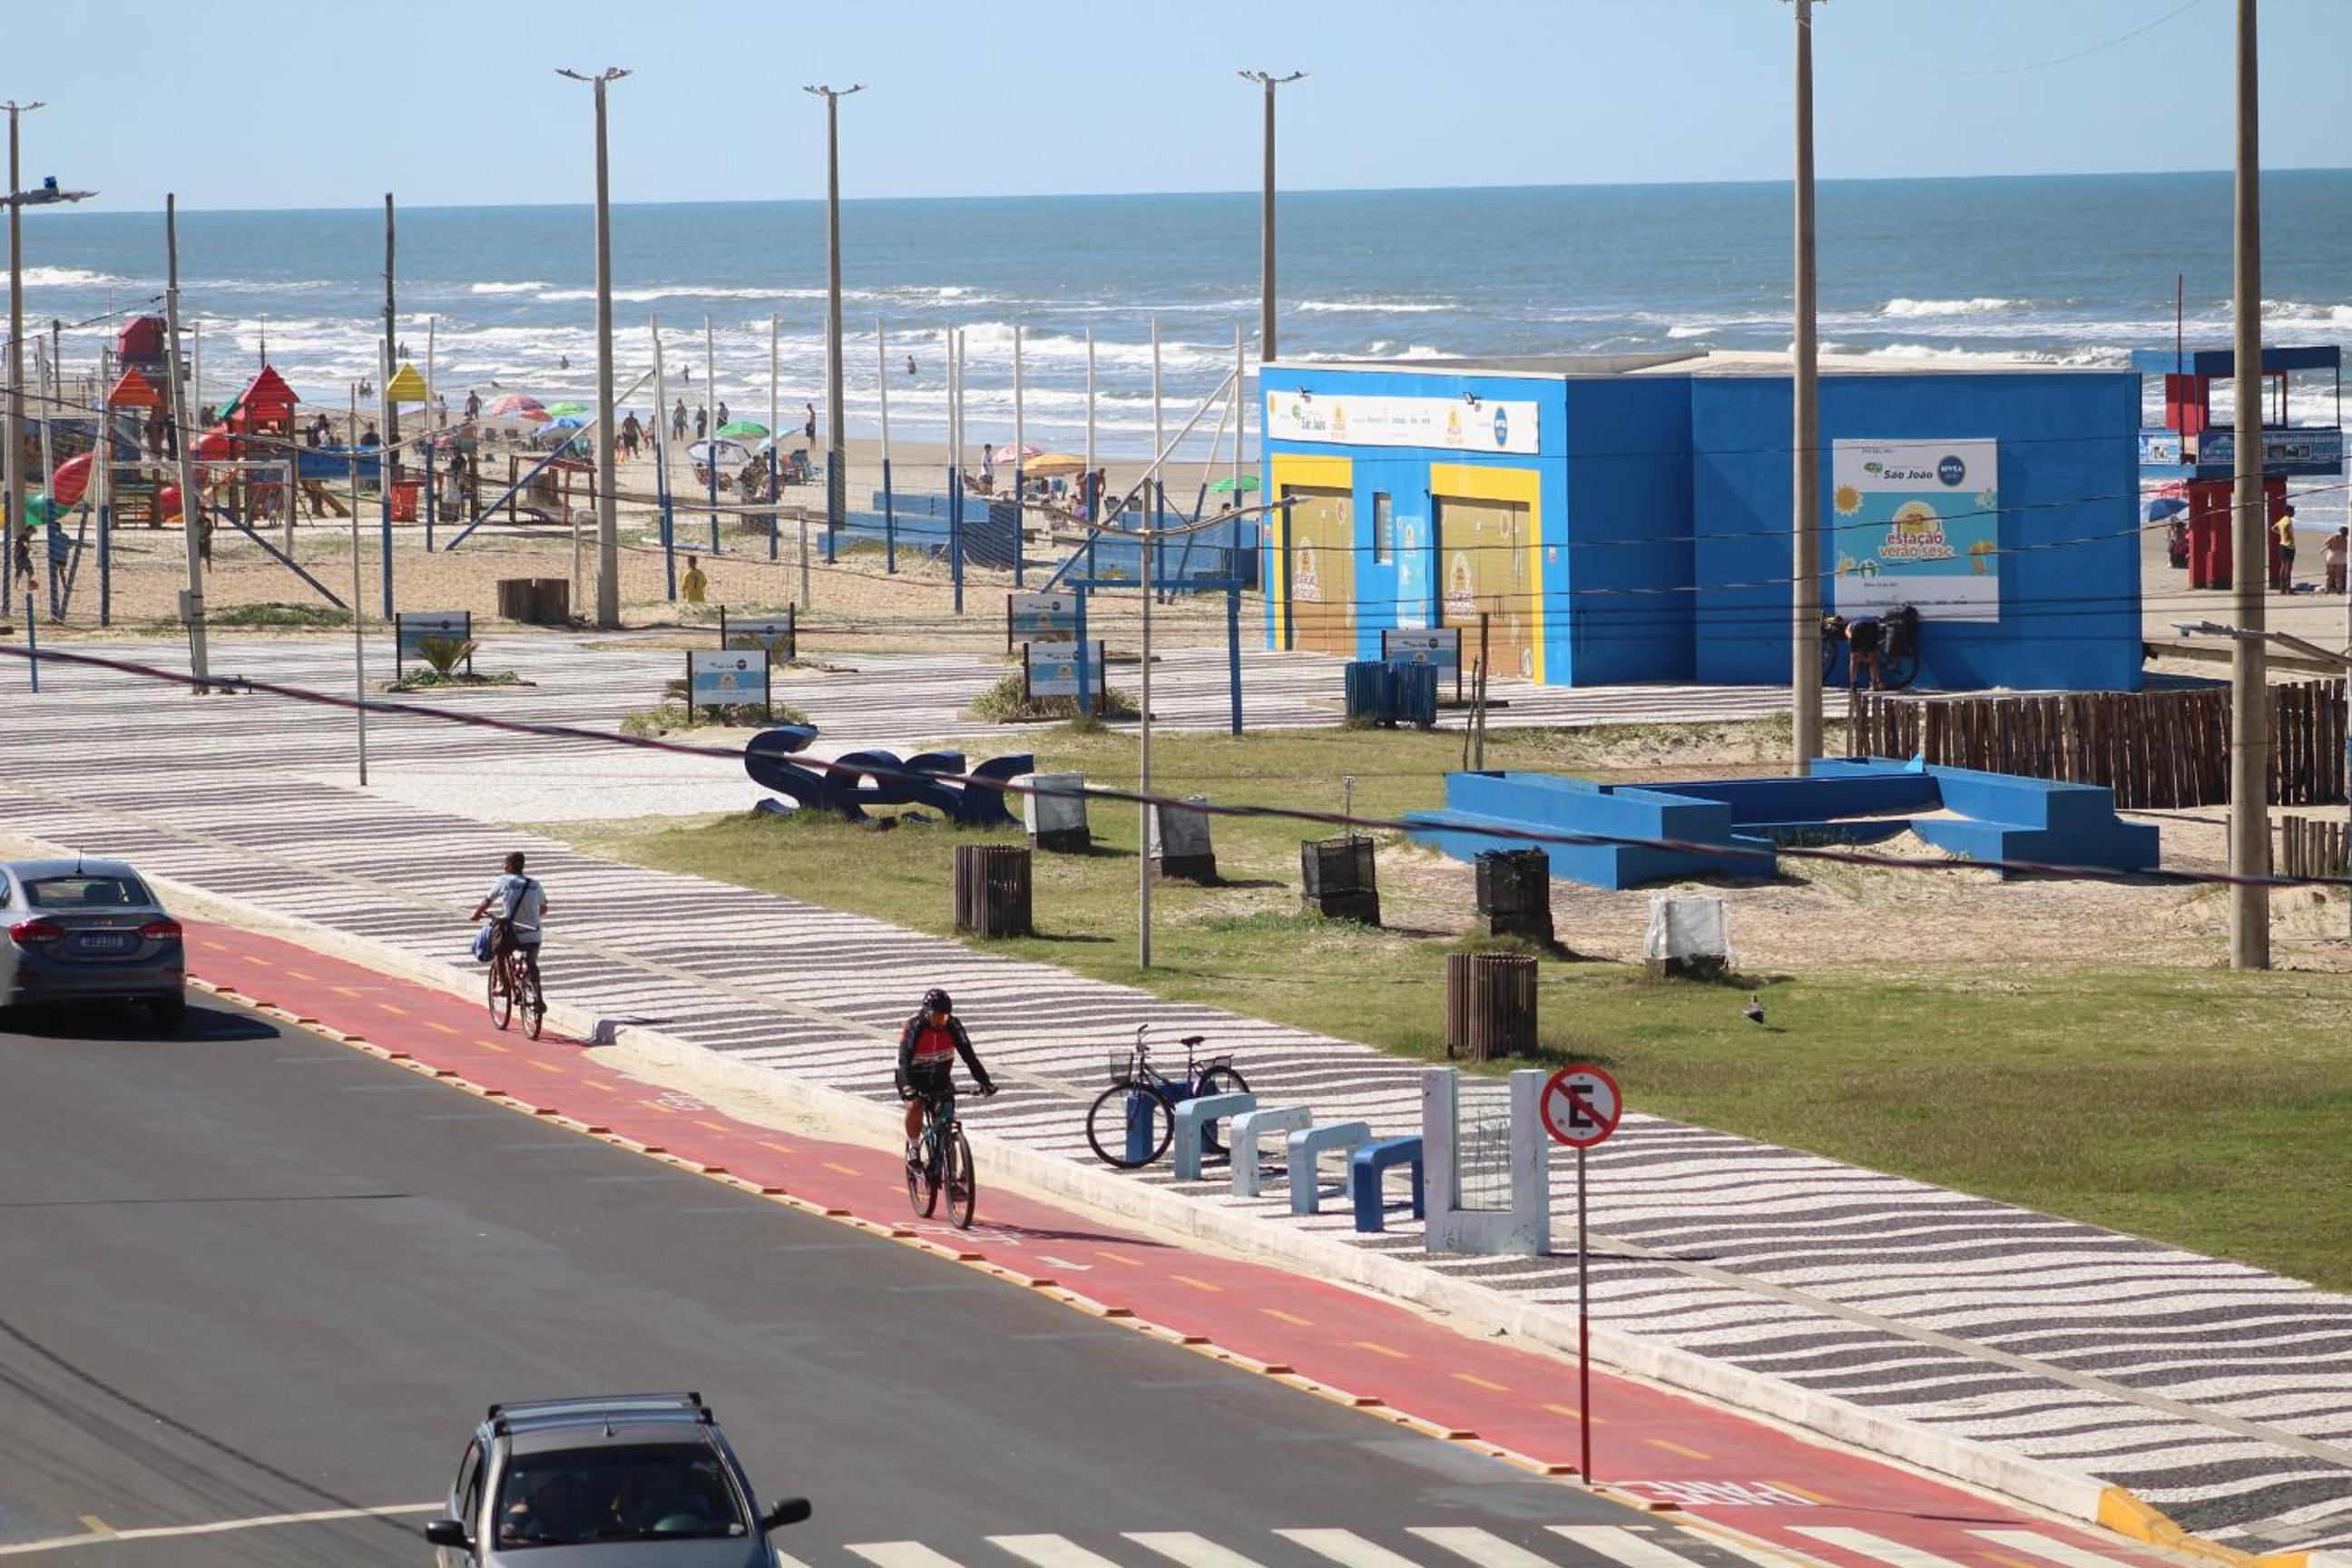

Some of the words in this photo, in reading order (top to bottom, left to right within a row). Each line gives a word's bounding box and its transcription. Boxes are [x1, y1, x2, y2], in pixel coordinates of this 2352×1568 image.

[1940, 465, 1962, 473] NIVEA
[1887, 531, 1942, 546] estação
[1880, 544, 1918, 557] verão
[1921, 546, 1953, 557] sesc
[1568, 1084, 1593, 1128] E
